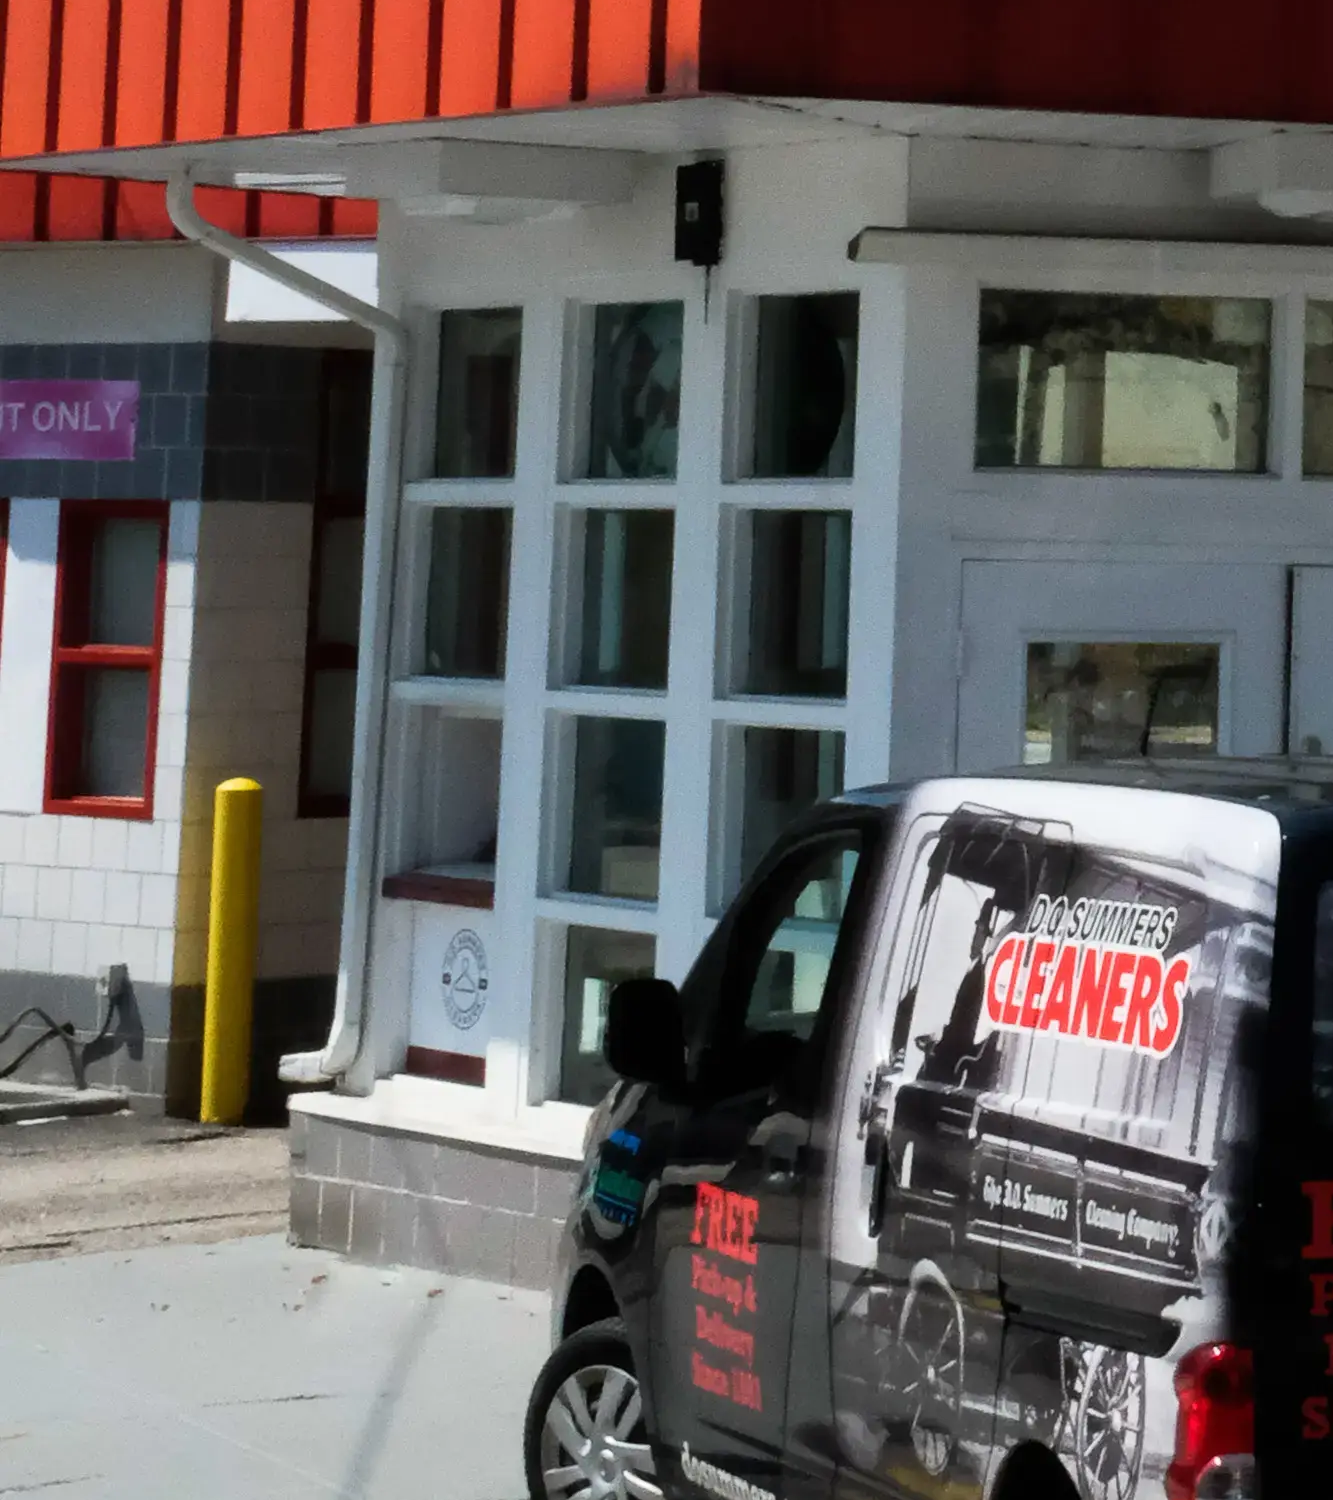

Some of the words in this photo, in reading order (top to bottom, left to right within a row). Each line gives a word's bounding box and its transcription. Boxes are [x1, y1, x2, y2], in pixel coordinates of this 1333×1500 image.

[0, 402, 26, 433] T
[32, 401, 124, 432] ONLY
[1067, 898, 1177, 951] SUMMERS
[986, 938, 1190, 1054] CLEANERS
[690, 1181, 760, 1265] FREE
[1022, 1183, 1069, 1222] Summers
